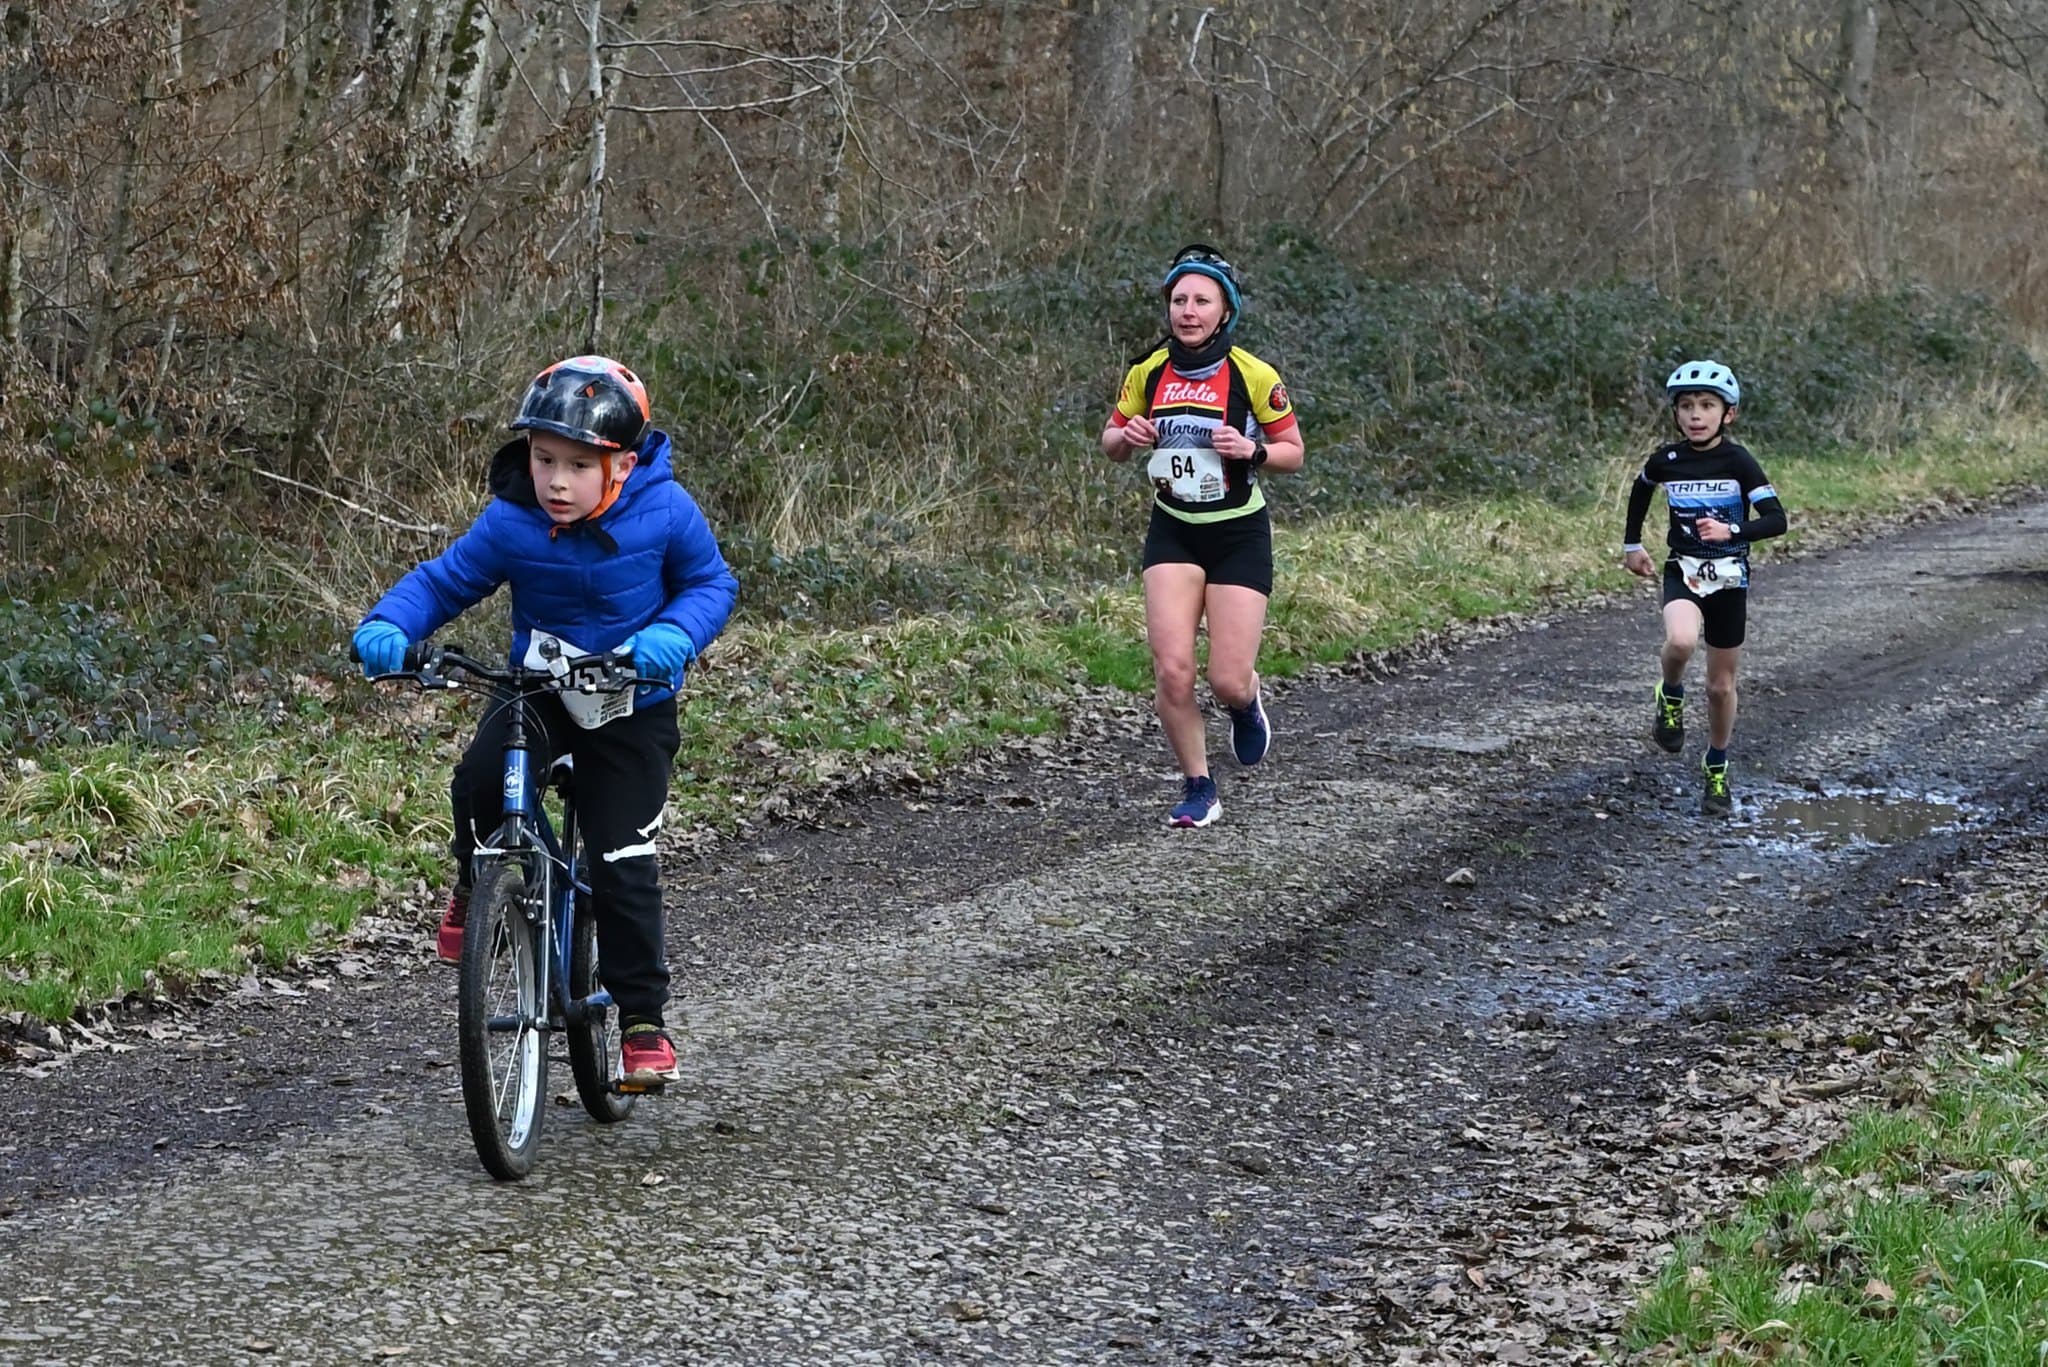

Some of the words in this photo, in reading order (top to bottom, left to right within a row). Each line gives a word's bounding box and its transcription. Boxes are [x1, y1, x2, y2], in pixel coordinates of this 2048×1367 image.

[1162, 382, 1218, 404] Fidelio
[1171, 455, 1195, 479] 64
[1670, 482, 1730, 493] TRITYC
[1697, 561, 1718, 582] 48
